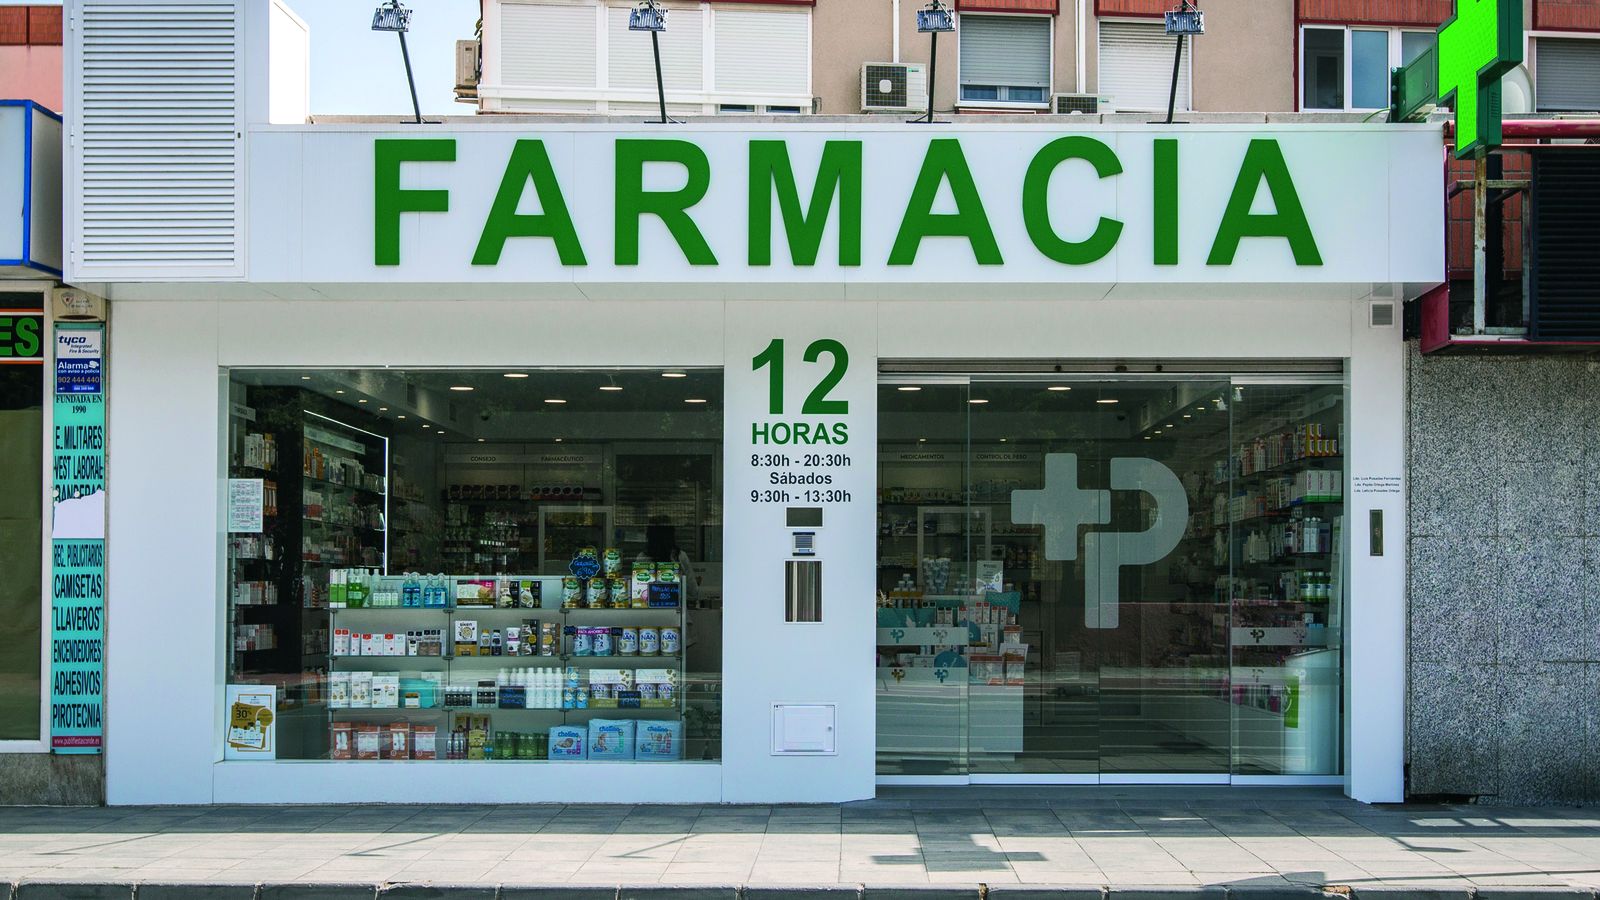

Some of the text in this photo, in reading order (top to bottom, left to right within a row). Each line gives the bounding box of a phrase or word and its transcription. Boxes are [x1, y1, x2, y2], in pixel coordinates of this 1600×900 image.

[374, 136, 1324, 267] FARMACIA
[58, 335, 87, 345] tyco
[58, 361, 88, 369] Alarma
[752, 338, 849, 414] 12
[56, 394, 103, 403] FUNDADA EN
[72, 405, 87, 414] 1990
[55, 426, 103, 449] E. MILITARES
[752, 422, 849, 445] HORAS
[751, 454, 790, 467] 8:30h
[803, 454, 851, 467] 20:30h
[770, 472, 832, 485] Sábados
[751, 490, 790, 502] 9:30h
[804, 490, 851, 502] 13:30h
[54, 544, 102, 567] REC. PUBLICITARIOS
[54, 574, 102, 598] CAMISETAS
[54, 639, 101, 663] ENCENDEDORES
[54, 671, 100, 695] ADHESIVOS
[53, 704, 101, 728] PIROTECNIA
